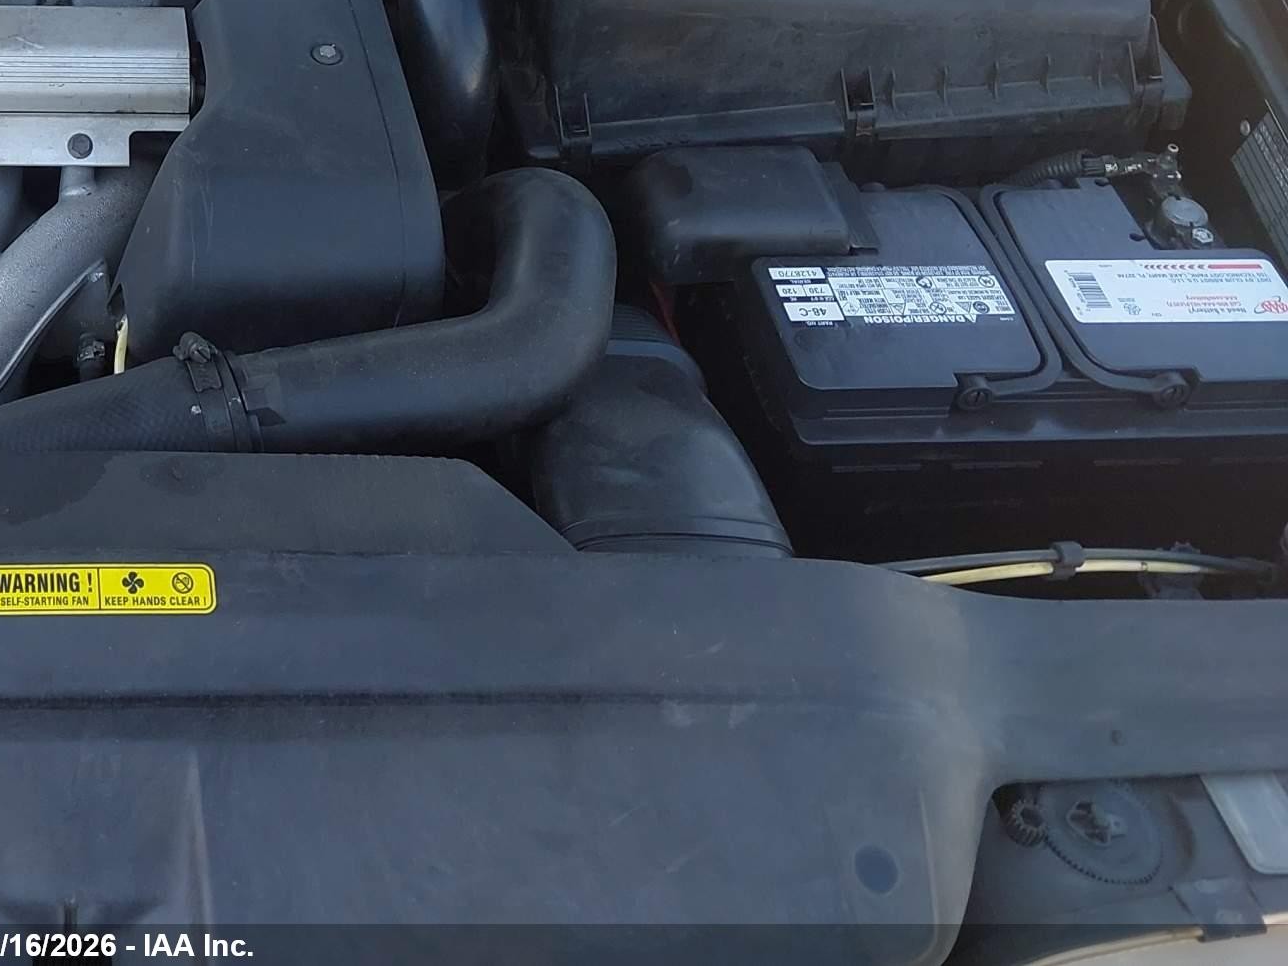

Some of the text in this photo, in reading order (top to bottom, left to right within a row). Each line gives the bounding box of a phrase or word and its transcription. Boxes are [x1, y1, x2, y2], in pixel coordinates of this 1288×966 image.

[798, 307, 827, 317] 48-C
[87, 572, 93, 593] !
[0, 595, 89, 607] SELF-STARTING FAN
[104, 596, 129, 606] KEEP
[132, 596, 167, 606] HANDS
[169, 596, 201, 606] CLEAR
